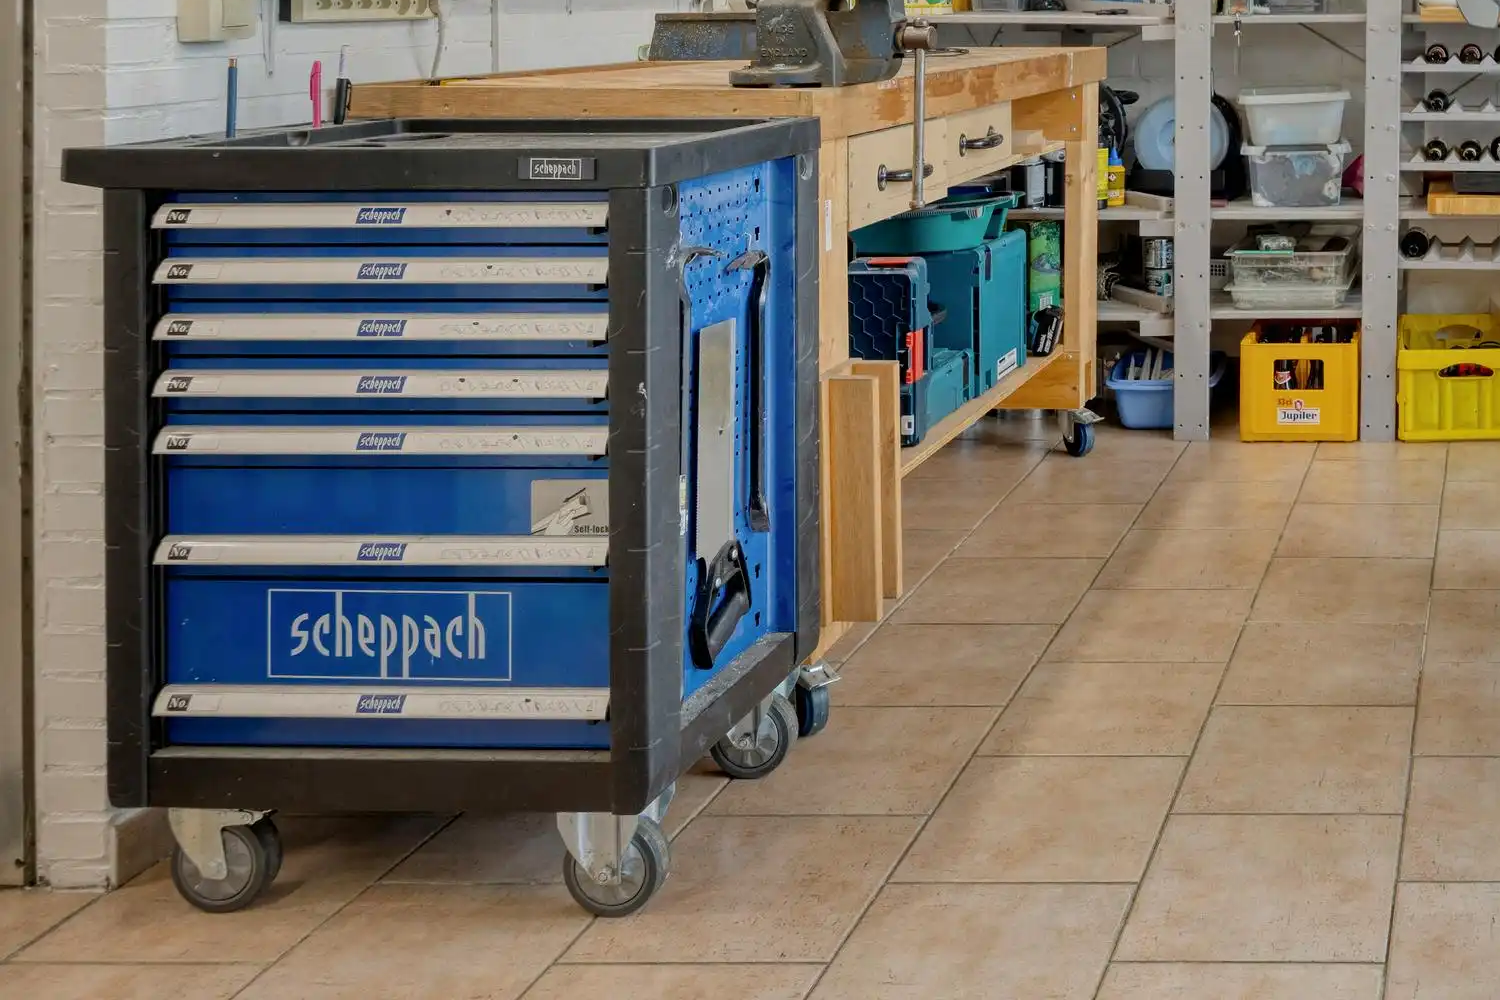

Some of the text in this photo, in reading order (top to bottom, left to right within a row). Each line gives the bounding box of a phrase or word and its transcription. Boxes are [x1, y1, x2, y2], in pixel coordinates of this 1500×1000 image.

[534, 159, 577, 179] scheppach
[359, 208, 403, 223] scheppach
[360, 263, 404, 279] scheppach
[360, 320, 403, 336] scheppach
[359, 376, 403, 393] scheppach
[1281, 411, 1317, 421] Jupiler
[360, 433, 403, 450] scheppach
[360, 543, 404, 560] scheppach
[290, 591, 486, 680] scheppach
[168, 697, 188, 708] No.
[359, 695, 403, 713] scheppach
